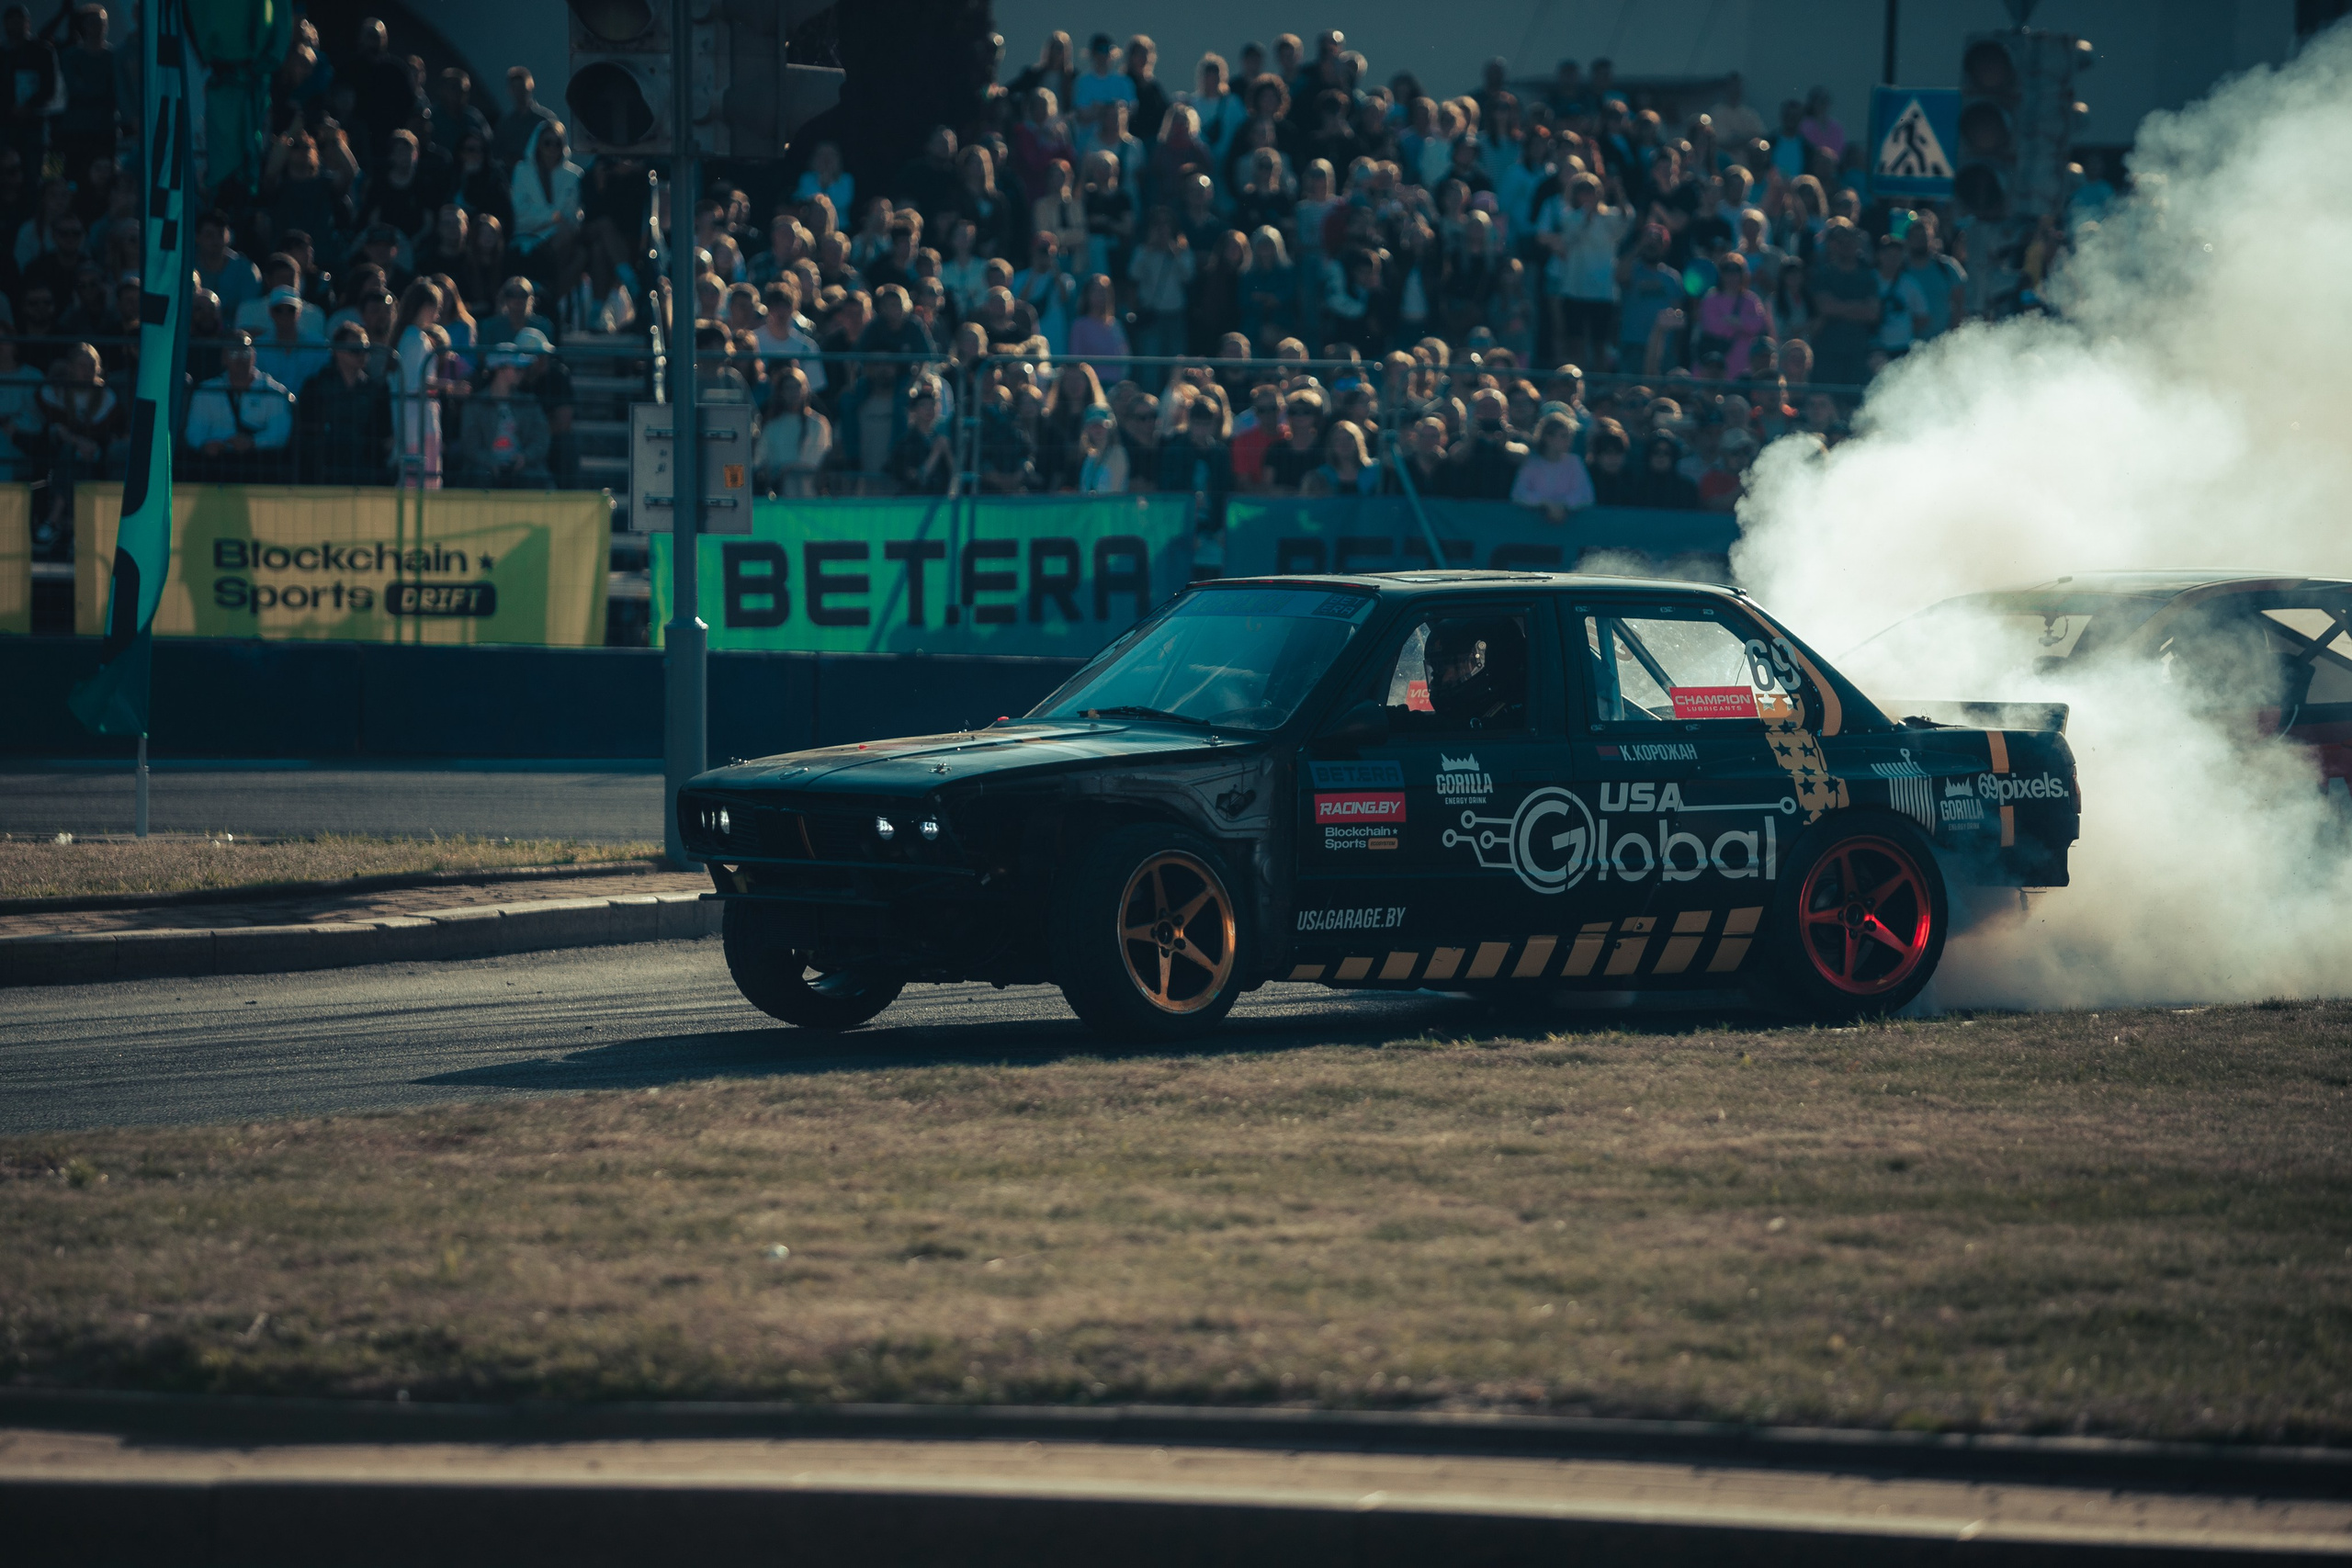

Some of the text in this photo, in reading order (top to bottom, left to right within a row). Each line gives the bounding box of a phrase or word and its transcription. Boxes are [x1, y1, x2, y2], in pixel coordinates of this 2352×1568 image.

[213, 538, 468, 571] Blockchain
[213, 576, 482, 614] Sports DRIFT
[1329, 592, 1366, 606] BET
[1747, 637, 1802, 691] 69
[1675, 694, 1750, 705] CHAMPION
[1436, 773, 1494, 795] GORILLA
[1319, 800, 1401, 816] RACING.BY
[1445, 796, 1487, 805] ENERGY DRINK
[1600, 782, 1684, 812] USA
[1940, 798, 1984, 821] GORILLA
[1325, 826, 1391, 838] Blockchain
[1519, 800, 1777, 883] Global
[1325, 838, 1366, 851] Sports
[1296, 907, 1407, 931] USAGARAGE.BY
